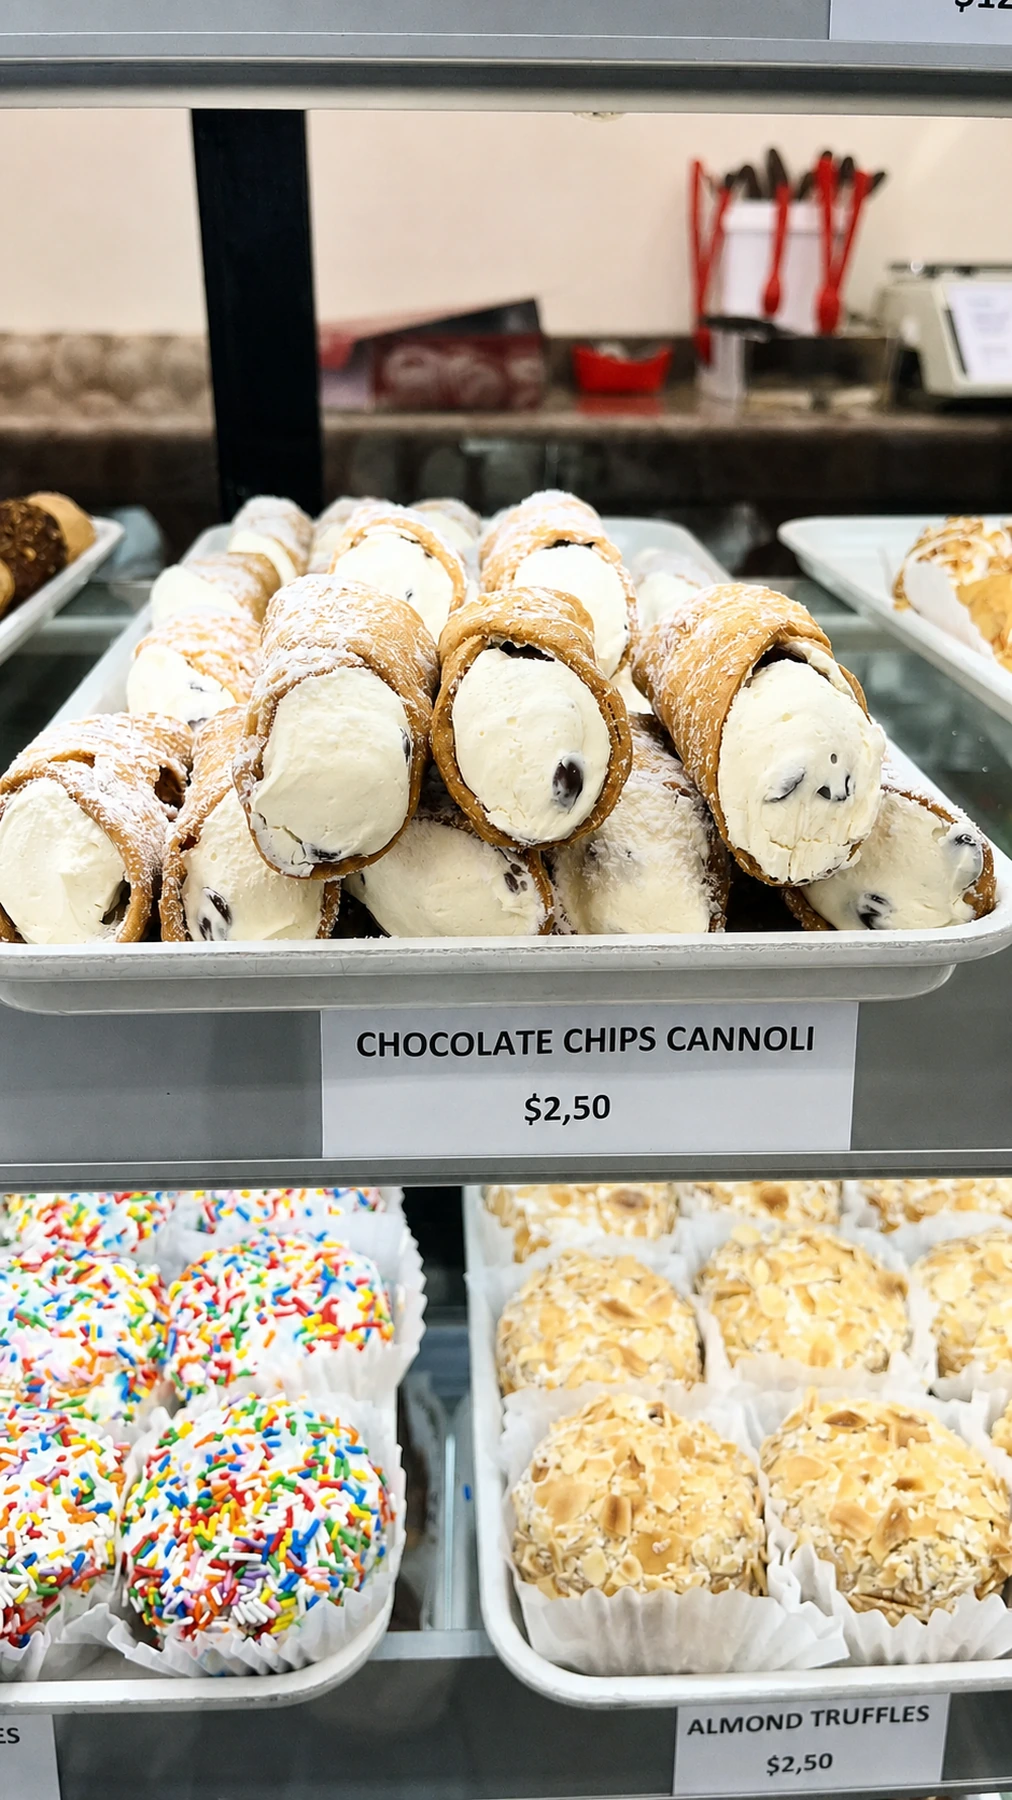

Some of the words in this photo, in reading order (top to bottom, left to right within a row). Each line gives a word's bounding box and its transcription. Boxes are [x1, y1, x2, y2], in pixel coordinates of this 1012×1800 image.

[356, 1029, 553, 1058] CHOCOLATE
[563, 1026, 657, 1054] CHIPS
[666, 1025, 815, 1052] CANNOLI
[524, 1092, 611, 1126] $2,50
[686, 1712, 804, 1736] ALMOND
[809, 1704, 930, 1727] TRUFFLES
[766, 1752, 834, 1777] $2,50
